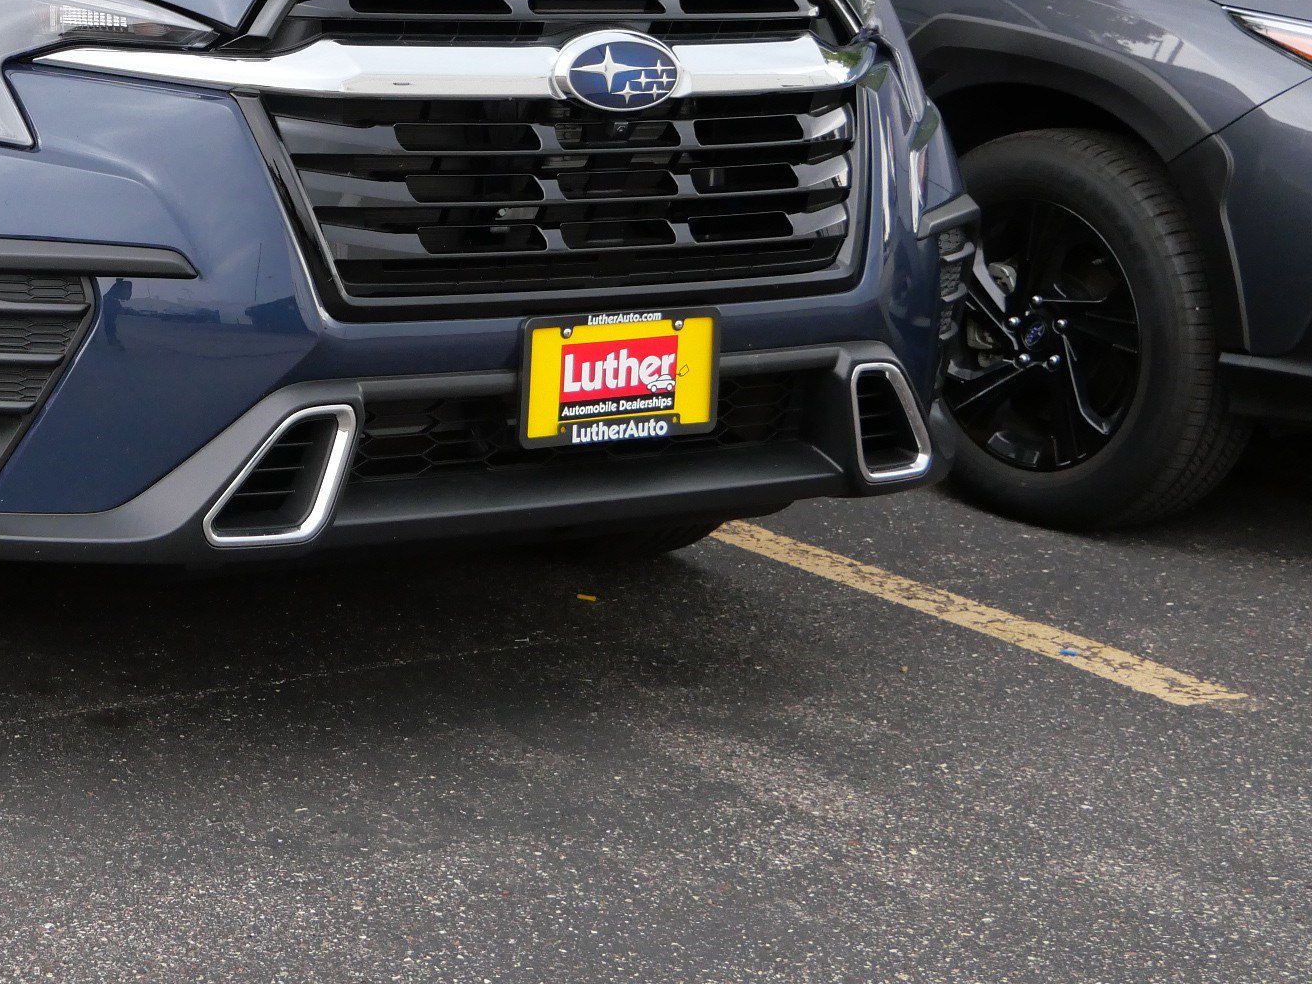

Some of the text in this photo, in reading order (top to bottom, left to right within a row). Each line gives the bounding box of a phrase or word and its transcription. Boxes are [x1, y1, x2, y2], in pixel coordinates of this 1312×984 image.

[588, 312, 662, 326] LutherAuto.com
[564, 349, 675, 392] Luther
[562, 396, 672, 417] Automobile Dealerships
[572, 419, 668, 443] LutherAuto
